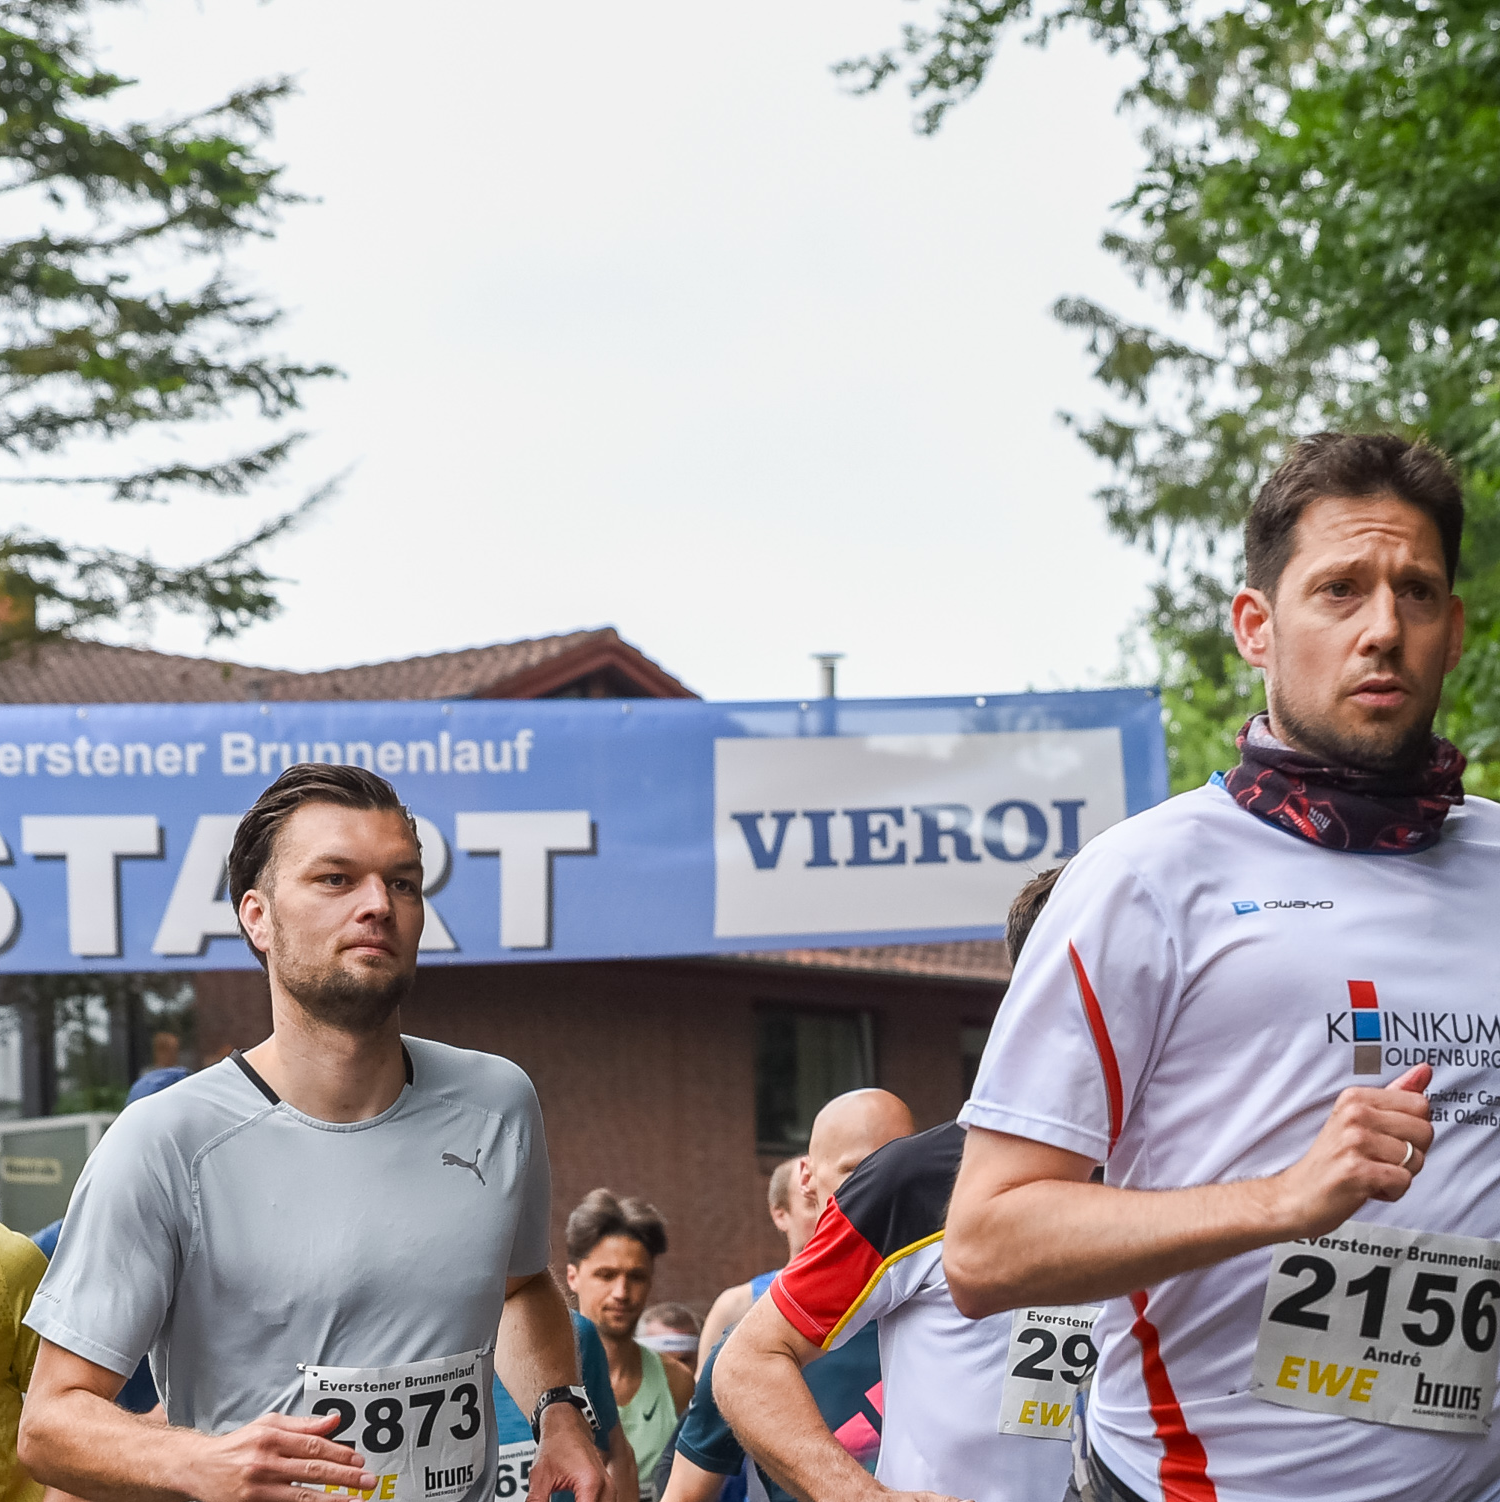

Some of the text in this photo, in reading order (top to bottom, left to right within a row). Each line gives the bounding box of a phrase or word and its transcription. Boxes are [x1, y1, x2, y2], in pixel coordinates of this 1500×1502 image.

[220, 728, 535, 778] Brunnenlauf
[1362, 1345, 1423, 1368] André
[319, 1363, 476, 1393] Everstener Brunnenlauf
[1275, 1354, 1380, 1404] EWE
[1413, 1371, 1483, 1412] bruns
[311, 1382, 481, 1454] 2873
[1018, 1399, 1073, 1428] EW
[424, 1463, 474, 1491] bruns
